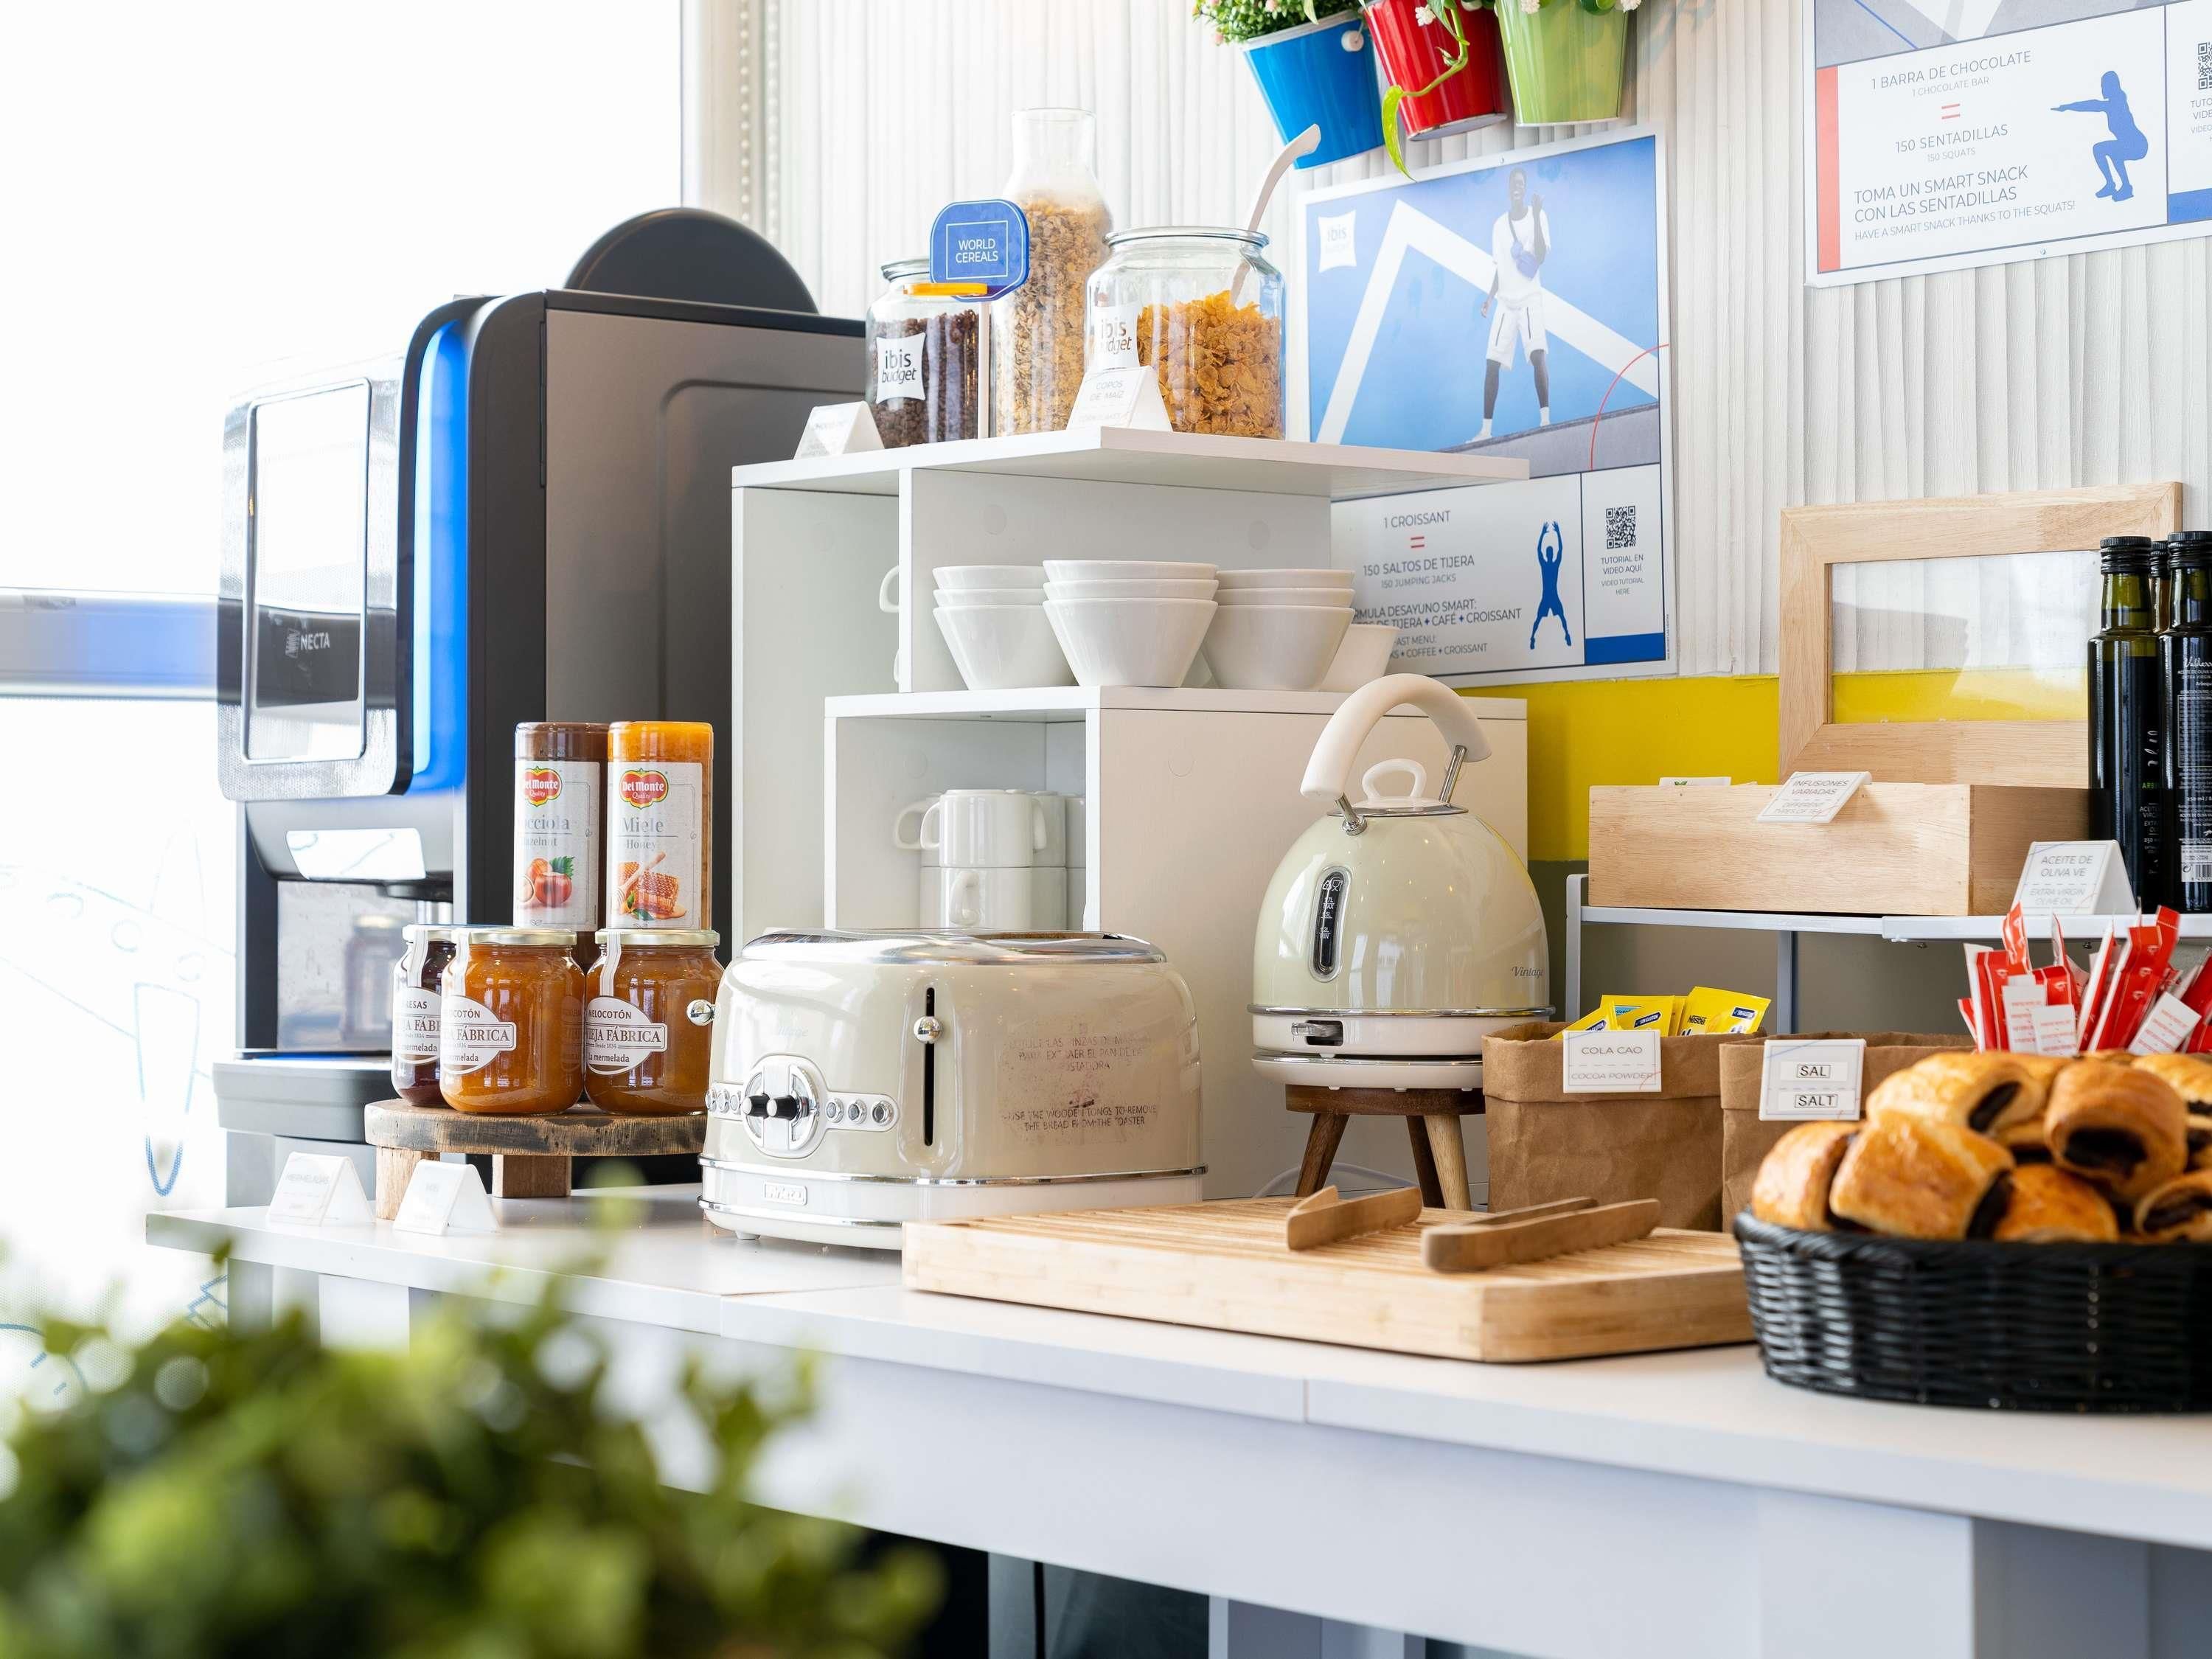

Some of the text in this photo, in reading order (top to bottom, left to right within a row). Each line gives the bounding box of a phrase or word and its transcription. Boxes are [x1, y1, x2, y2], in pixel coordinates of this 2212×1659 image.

[1871, 50, 2032, 89] 1 BARRA DE CHOCOLATE
[1918, 80, 1969, 97] CHOCOLATE
[1972, 76, 1991, 87] BAR
[2190, 97, 2212, 108] TUTO
[2193, 110, 2212, 119] VIDE
[1896, 124, 2008, 154] 150 SENTADILLAS
[1927, 147, 1977, 163] 150 SQUATS
[1854, 164, 2029, 205] TOMA UN SMART SNACK
[1854, 187, 2017, 223] CON LAS SENTADILLAS
[1854, 200, 2076, 241] HAVE A SMART SNACK THANKS TO THE SQUATS!
[959, 238, 996, 251] WORLD
[955, 251, 999, 263] CEREALS
[1101, 316, 1127, 339] ibis
[884, 349, 912, 369] ibis
[881, 368, 917, 385] budget
[1384, 509, 1451, 529] 1 CROISSANT
[1363, 554, 1475, 577] 150 SALTOS DE TIJERA
[1601, 554, 1632, 565] TUTORIAL
[1603, 566, 1624, 575] VIDEO
[1381, 573, 1457, 589] 150 JUMPING JACKS
[1601, 577, 1645, 588] VIDEO TUTORIAL
[1615, 587, 1631, 596] HERE
[1354, 598, 1477, 620] RMULA DESAYUNO SMART:
[1391, 617, 1422, 629] TIJERA
[1431, 612, 1457, 627] CAFÉ
[1466, 608, 1523, 625] CROISSANT
[300, 632, 330, 651] NECTA
[1412, 635, 1436, 644] MENU:
[1406, 647, 1437, 658] COFFEE
[1444, 642, 1488, 655] CROISSANT
[532, 779, 559, 790] Monte
[622, 780, 664, 792] Del Monte
[529, 790, 546, 799] Quality
[632, 791, 651, 800] Quality
[525, 814, 570, 831] cciola
[623, 816, 664, 833] Miele
[2041, 855, 2094, 865] ACEITE DE
[2040, 868, 2088, 877] OLIVA VE
[453, 1008, 481, 1019] COTÓN
[457, 1025, 510, 1042] FÁBRICA
[589, 1026, 661, 1043] IEJA FÁBRICA
[403, 1043, 437, 1052] ermelada
[1071, 1036, 1098, 1047] INZAS
[1582, 1046, 1643, 1055] COLA CAO
[594, 1053, 630, 1063] mermelada
[1571, 1071, 1653, 1080] COCOA POWDER
[1800, 1065, 1827, 1077] SAL
[1798, 1095, 1836, 1107] SALT
[1087, 1106, 1113, 1117] TONGS
[1115, 1106, 1125, 1116] TO
[1097, 1117, 1111, 1127] THE
